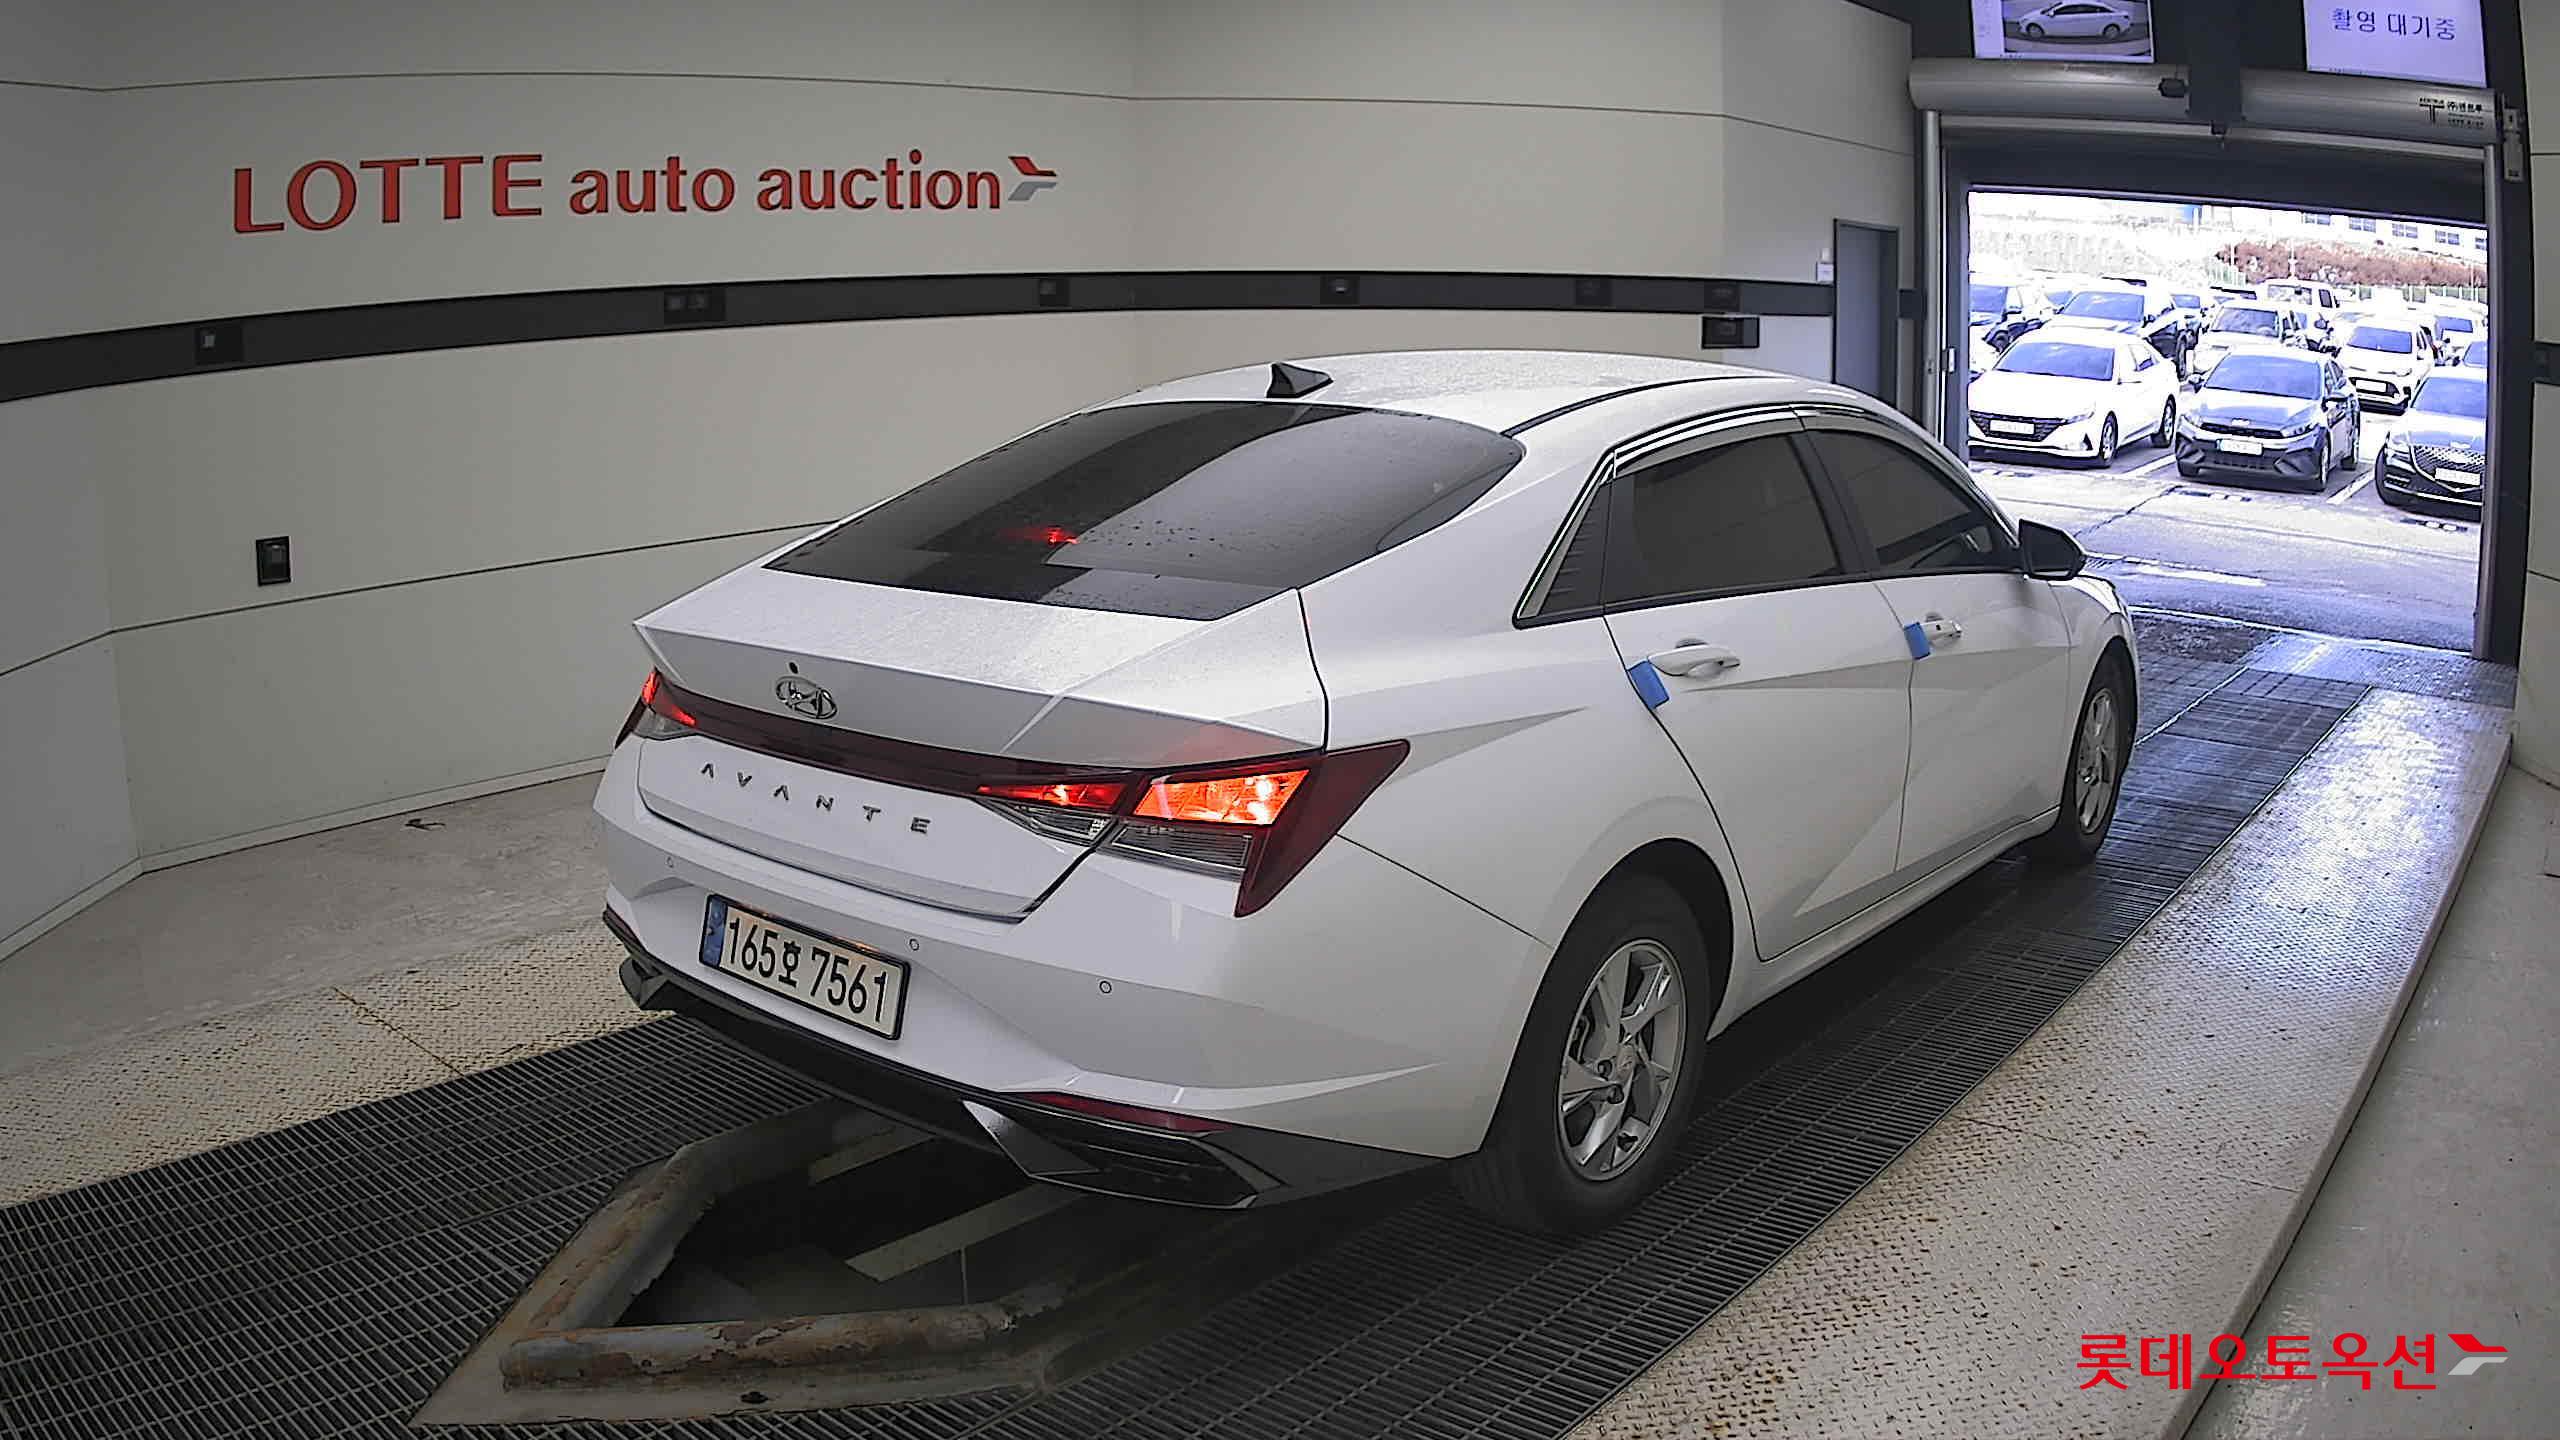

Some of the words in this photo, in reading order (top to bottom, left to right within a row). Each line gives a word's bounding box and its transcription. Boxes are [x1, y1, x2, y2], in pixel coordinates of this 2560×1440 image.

[2333, 8, 2377, 33] 촬영
[2387, 13, 2455, 40] 대기중
[233, 153, 543, 234] LOTTE
[568, 155, 736, 215] auto
[756, 149, 1000, 211] auction
[701, 763, 931, 834] AVANTE
[729, 917, 801, 988] 165호
[810, 946, 887, 1022] 7561
